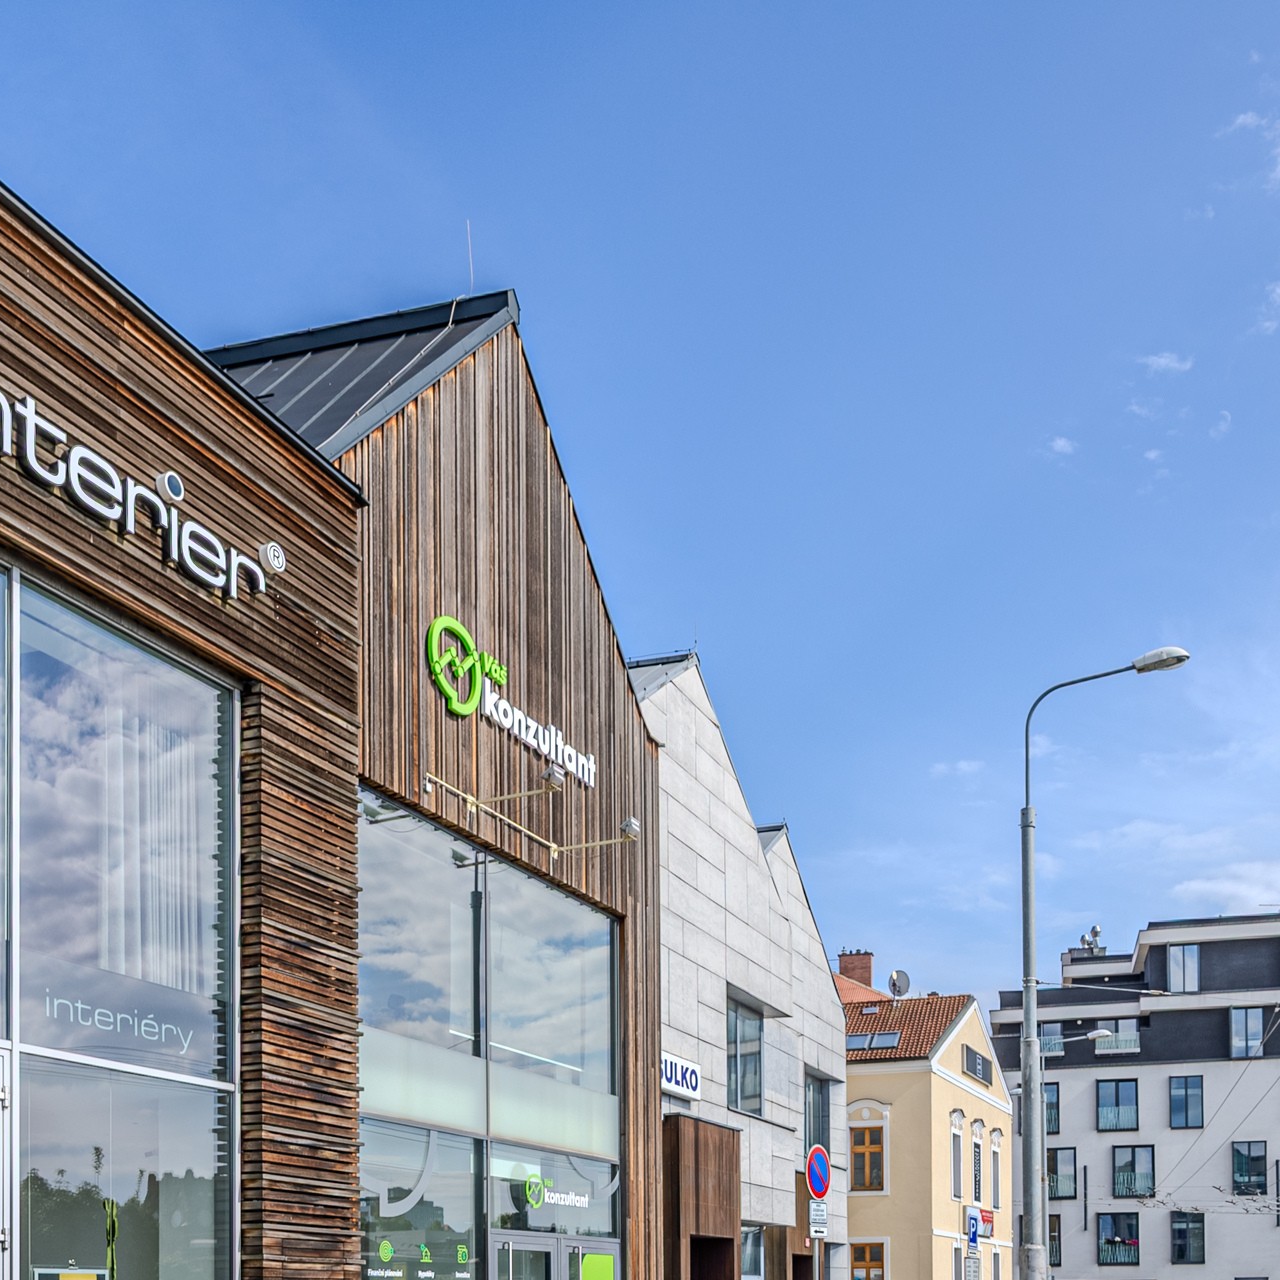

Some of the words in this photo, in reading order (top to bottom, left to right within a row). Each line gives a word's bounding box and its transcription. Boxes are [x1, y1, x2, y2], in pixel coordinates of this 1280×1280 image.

[480, 651, 508, 686] Váš
[482, 677, 595, 788] konzultant
[45, 988, 194, 1054] interiéry
[544, 1188, 589, 1208] konzultant
[970, 1219, 977, 1239] P
